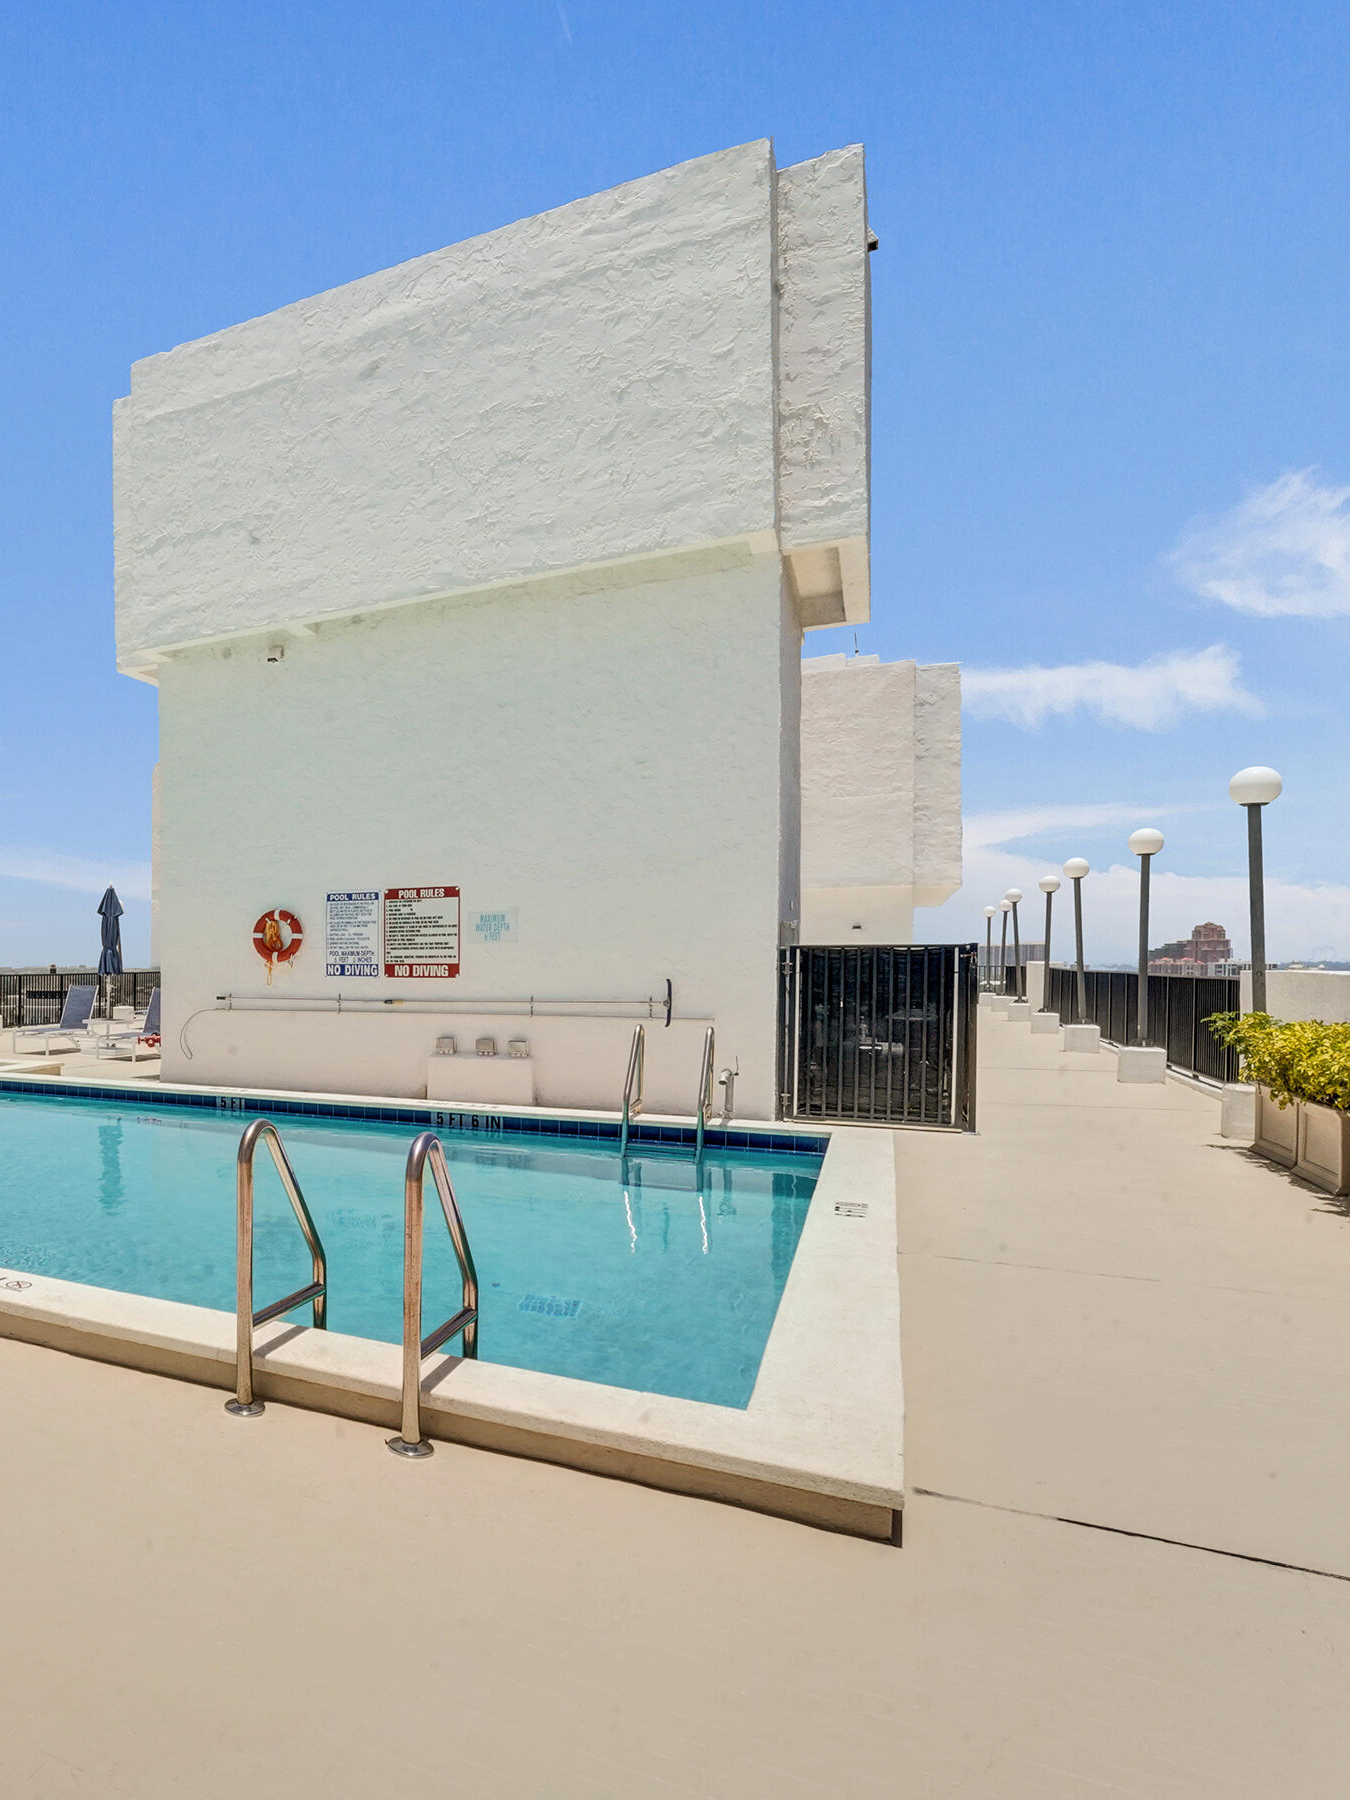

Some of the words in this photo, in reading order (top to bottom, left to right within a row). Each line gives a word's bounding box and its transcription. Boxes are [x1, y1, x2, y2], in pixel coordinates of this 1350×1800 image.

[352, 893, 376, 901] RULES
[398, 889, 419, 899] POOL
[420, 888, 445, 898] RULES
[475, 923, 492, 932] WATER
[328, 964, 341, 975] NO
[344, 964, 378, 975] DIVING
[394, 965, 410, 976] NO
[412, 965, 449, 977] DIVING
[220, 1096, 226, 1108] 5
[437, 1112, 443, 1125] 5
[449, 1113, 466, 1127] FT
[471, 1114, 479, 1128] 6
[486, 1115, 500, 1129] IN
